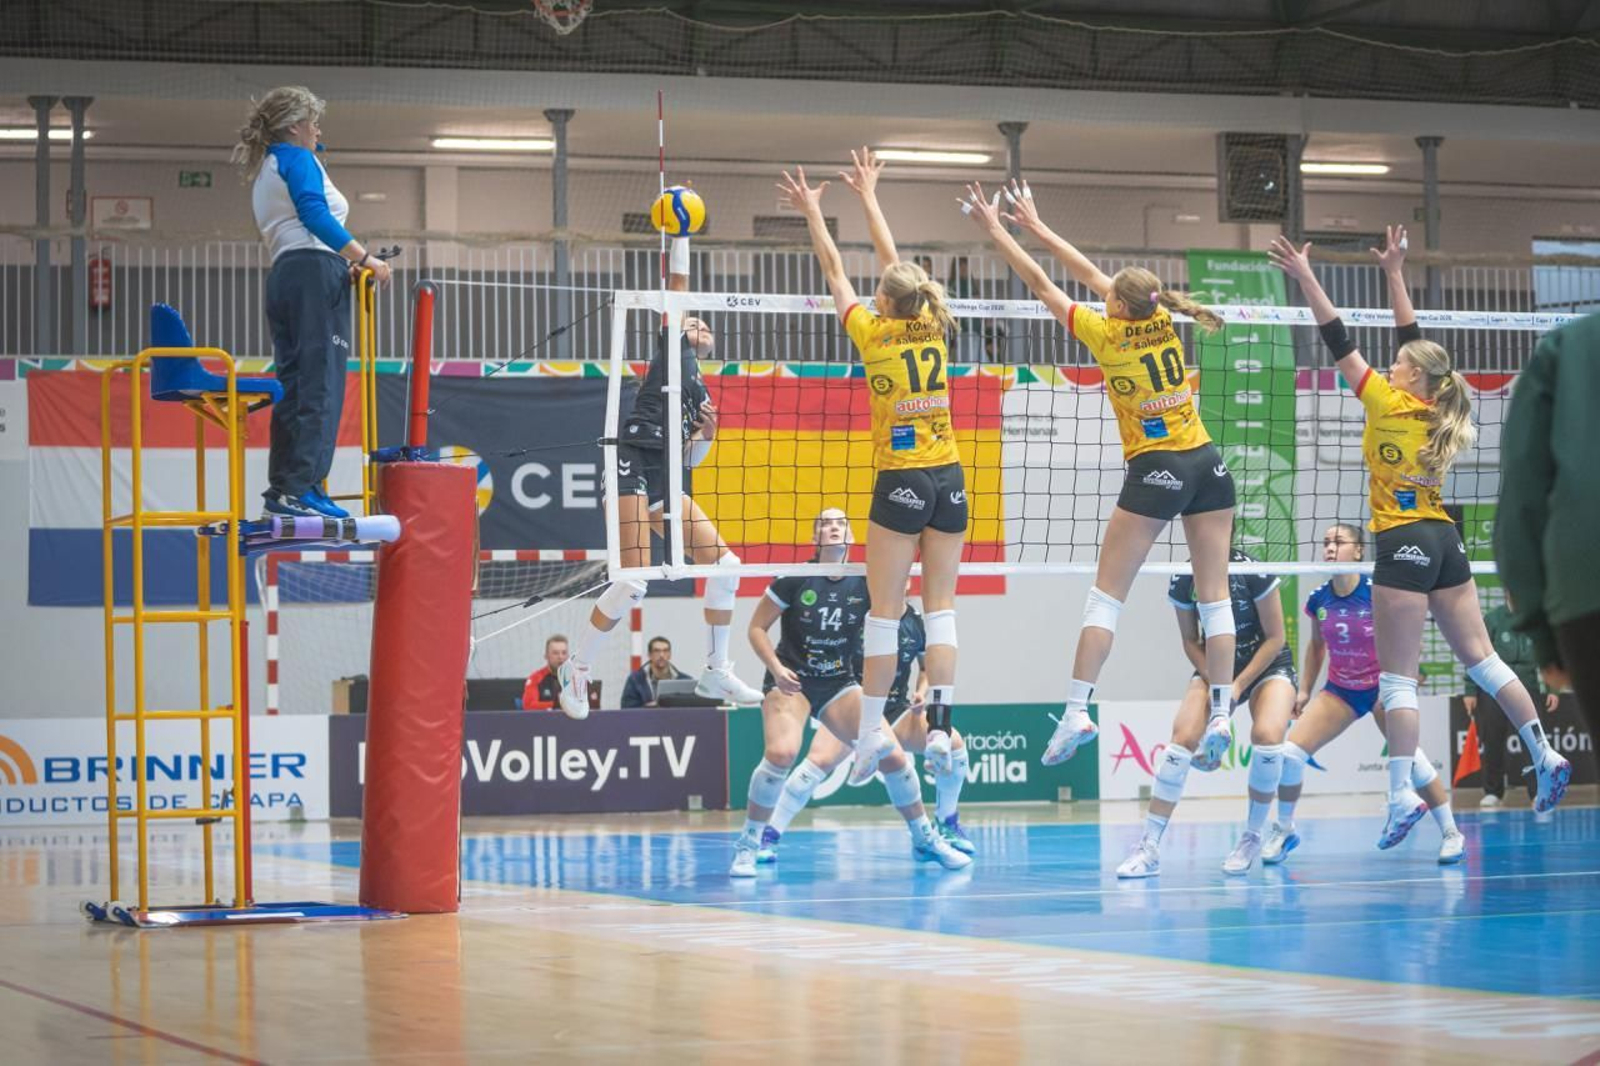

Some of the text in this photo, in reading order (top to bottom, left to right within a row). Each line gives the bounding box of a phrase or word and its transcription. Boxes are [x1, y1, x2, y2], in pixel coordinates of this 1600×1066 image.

[740, 299, 761, 307] CEV
[1125, 325, 1141, 338] DE
[900, 347, 945, 393] 12
[1139, 347, 1184, 393] 10
[511, 462, 598, 509] CE
[818, 607, 843, 632] 14
[1335, 622, 1350, 644] 3
[44, 752, 307, 784] BRINNER
[923, 753, 1028, 785] villa
[0, 795, 132, 814] DUCTOS
[151, 794, 188, 810] DE
